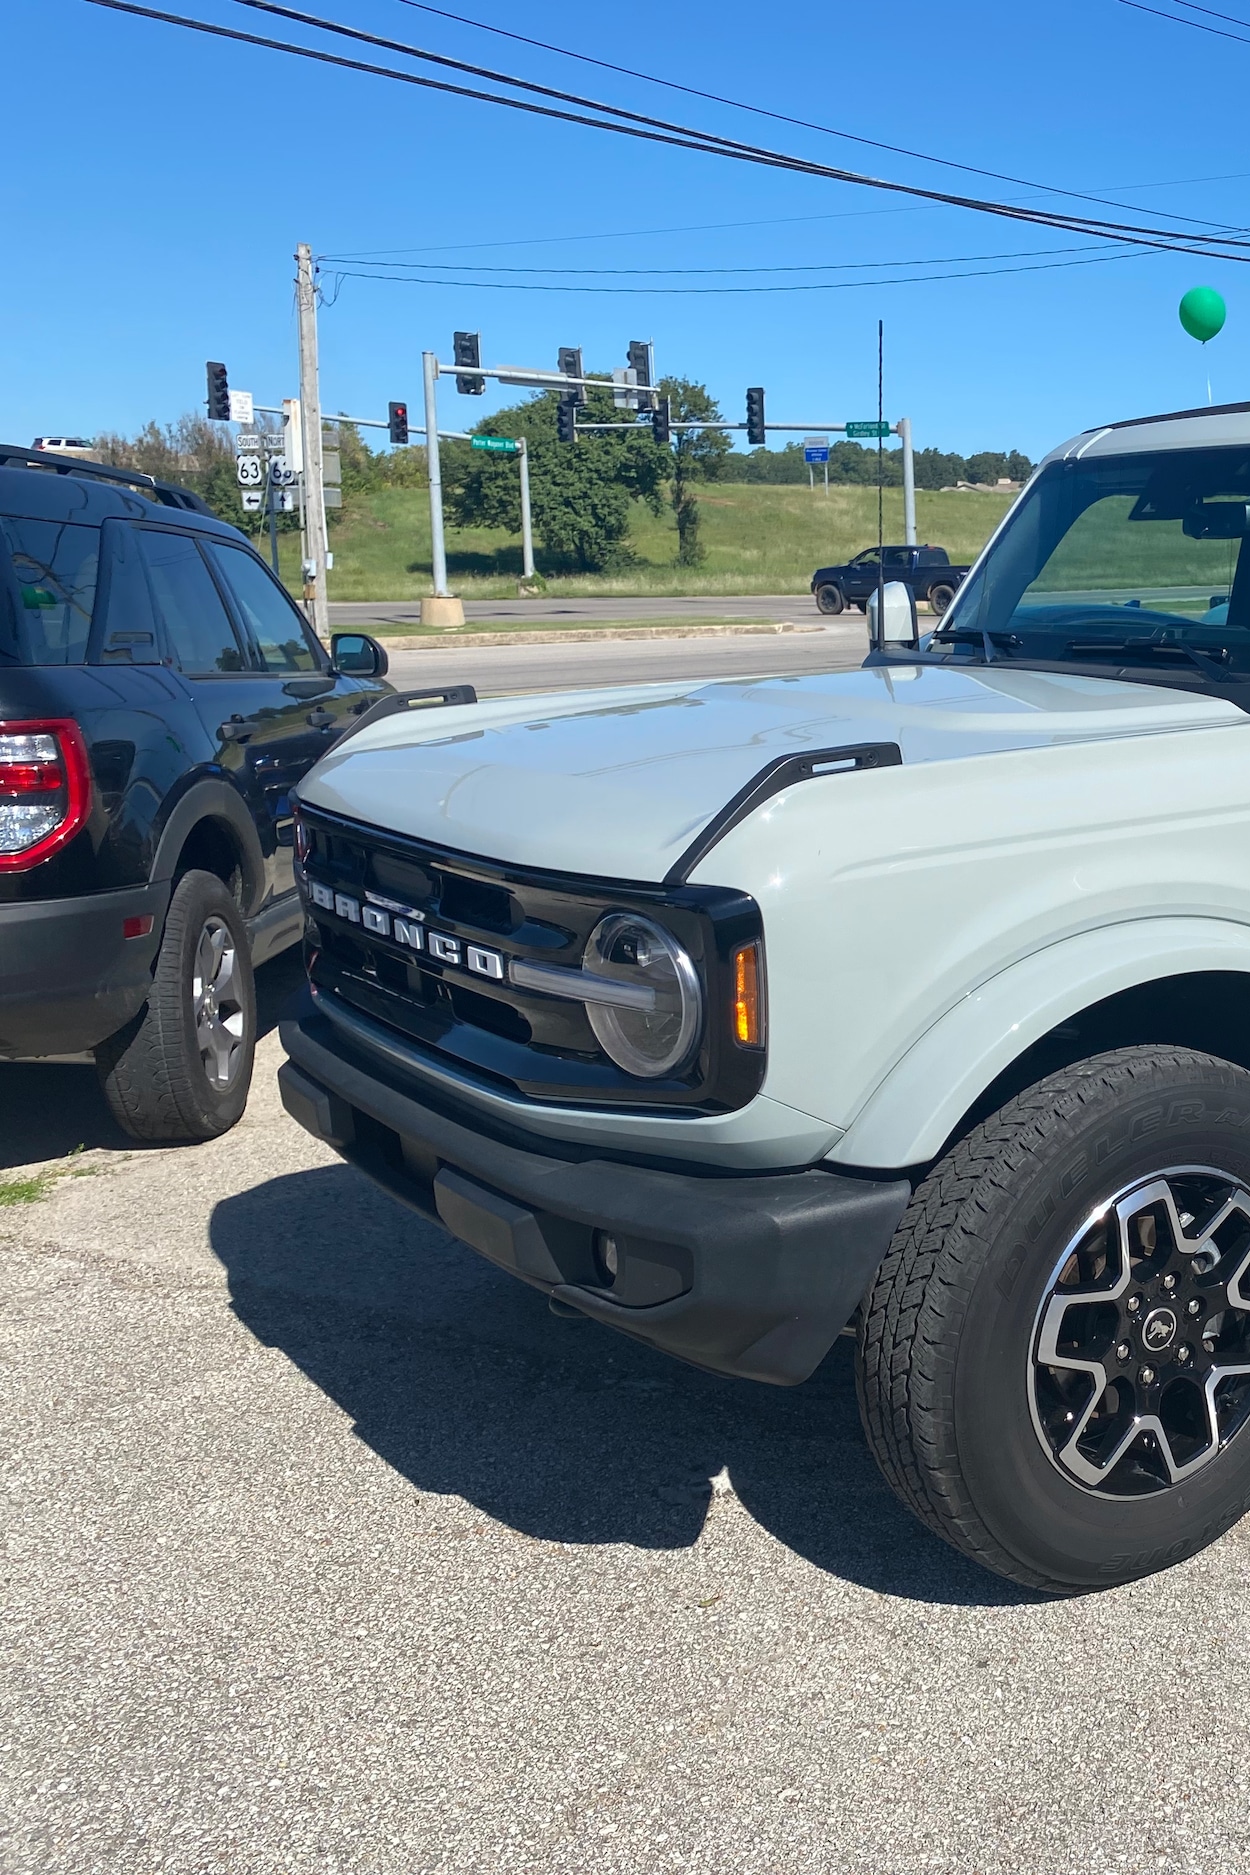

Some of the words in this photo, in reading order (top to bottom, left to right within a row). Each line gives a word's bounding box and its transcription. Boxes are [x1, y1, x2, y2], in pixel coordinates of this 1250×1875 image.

[238, 436, 258, 447] SOUTH
[268, 436, 285, 446] NORT
[240, 462, 259, 478] 63
[312, 881, 504, 979] BRONCO
[993, 1098, 1206, 1302] DUELER
